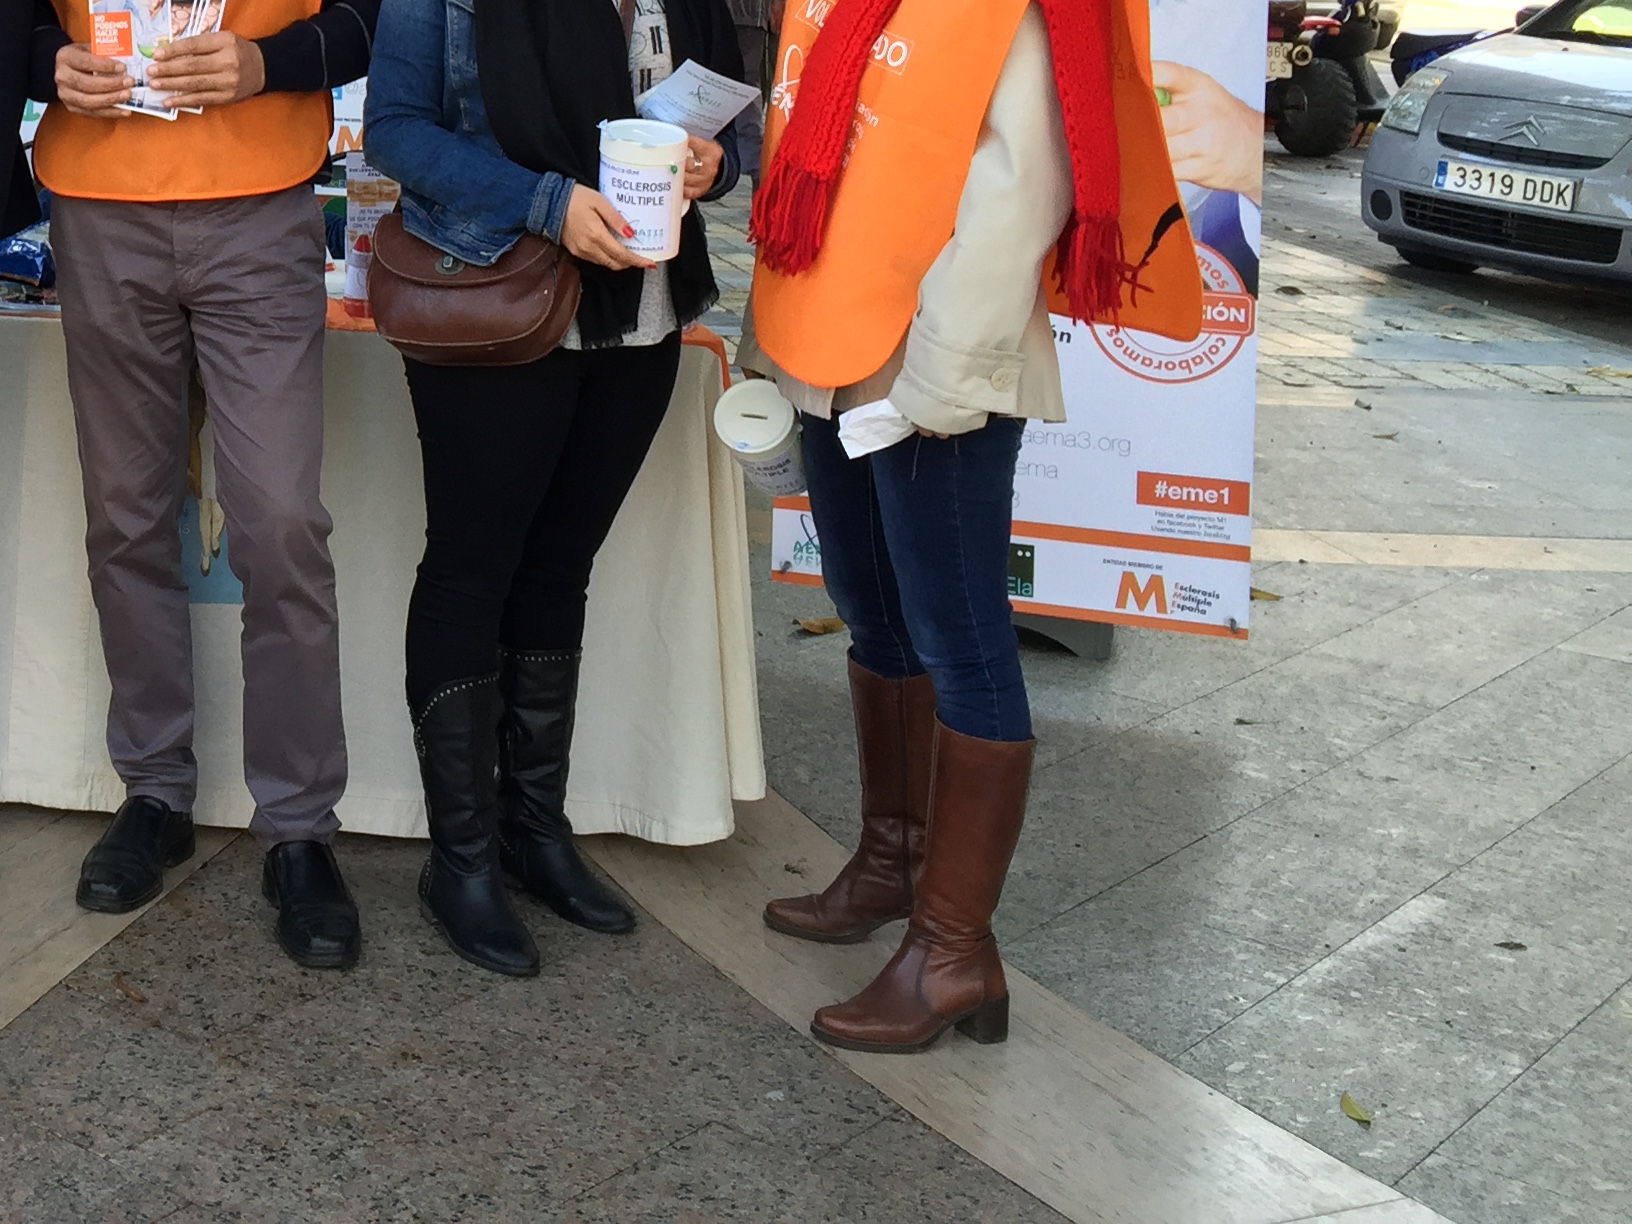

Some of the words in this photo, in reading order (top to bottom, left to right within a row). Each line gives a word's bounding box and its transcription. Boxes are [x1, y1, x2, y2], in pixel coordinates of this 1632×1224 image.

[1267, 46, 1289, 57] 960
[611, 177, 671, 192] ESCLEROSIS
[1453, 166, 1514, 196] 3319
[1523, 178, 1571, 207] DDK
[616, 192, 665, 206] MÚLTIPLE
[1106, 328, 1227, 374] colaboramos
[1021, 428, 1131, 457] aema3.org
[1154, 480, 1230, 505] #eme1
[1115, 571, 1168, 614] M
[1174, 582, 1220, 599] Esclerosis
[1171, 600, 1207, 615] España
